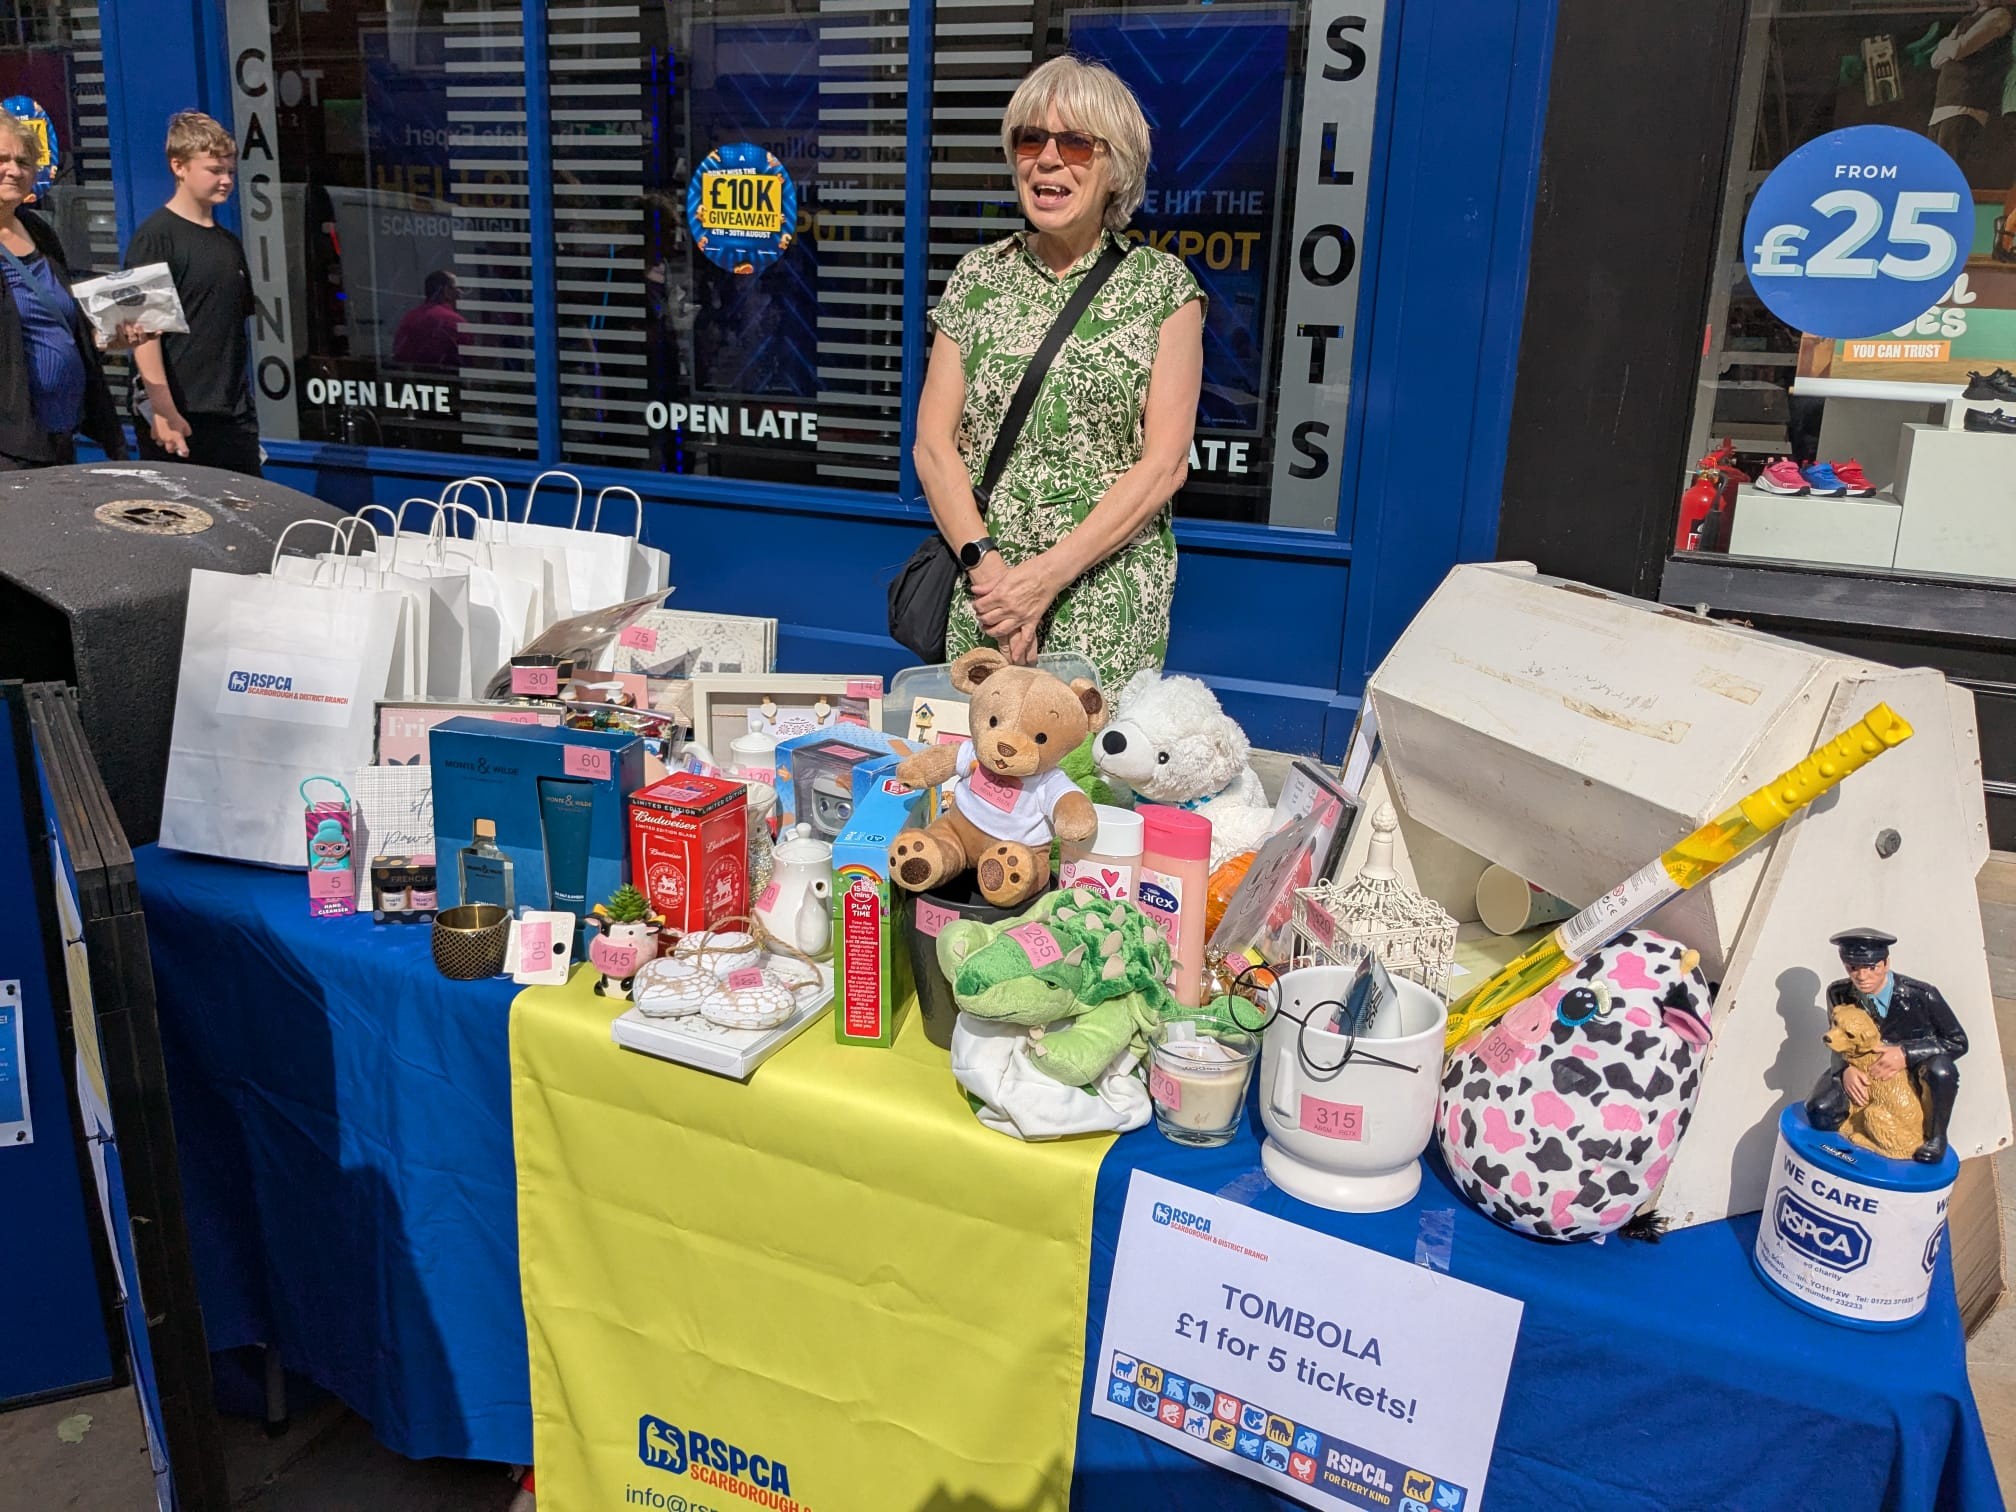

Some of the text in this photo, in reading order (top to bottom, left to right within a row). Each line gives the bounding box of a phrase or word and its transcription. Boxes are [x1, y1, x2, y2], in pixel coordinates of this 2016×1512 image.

[742, 167, 757, 175] THE
[1834, 164, 1898, 179] FROM
[709, 177, 775, 213] £10K
[1164, 190, 1206, 214] HIT
[1212, 190, 1264, 216] THE
[235, 48, 292, 400] CASINO
[709, 211, 777, 228] GIVEAWAY!
[744, 231, 771, 239] AUGUST
[1751, 189, 1961, 282] £25
[1122, 230, 1261, 270] KPOT
[1287, 15, 1368, 481] SLOTS
[1853, 343, 1941, 359] YOU CAN TRUST
[307, 377, 452, 415] OPEN LATE
[645, 400, 819, 443] OPEN LATE
[1187, 439, 1250, 473] ATE
[634, 630, 649, 643] 75
[249, 672, 293, 692] RSPCA
[529, 672, 548, 686] 30
[247, 687, 294, 700] SCARBOROUGH
[299, 693, 325, 703] DISTRICT
[324, 695, 349, 705] BRANCH
[387, 716, 427, 738] Fri
[477, 756, 491, 775] &
[492, 765, 519, 776] WILDE
[581, 753, 601, 768] 60
[565, 794, 575, 807] &
[632, 799, 696, 816] LIMITED EDITION
[702, 801, 725, 815] LIMITED
[632, 809, 697, 831] Budweiser
[635, 823, 697, 839] LIMITED EDITION GLASS
[331, 876, 341, 889] 5
[390, 875, 428, 883] FRENCH
[854, 891, 871, 899] mins
[1139, 888, 1174, 910] arex
[851, 903, 872, 911] PLAY
[852, 910, 871, 918] TIME
[532, 941, 545, 961] 50
[1025, 928, 1056, 958] 265
[602, 949, 630, 966] 145
[1488, 1035, 1514, 1065] 305
[1316, 1107, 1356, 1129] 315
[1783, 1154, 1879, 1215] WE CARE
[1172, 1207, 1211, 1234] RSPCA
[1781, 1203, 1853, 1258] RSPCA
[1170, 1221, 1213, 1244] SCARBOROUGH
[1218, 1237, 1244, 1253] DISTRICT
[1244, 1245, 1269, 1262] BRANCH
[1814, 1266, 1843, 1282] charity
[1805, 1286, 1834, 1302] number
[1856, 1295, 1870, 1303] Tel:
[1222, 1283, 1382, 1366] TOMBOLA
[1174, 1312, 1418, 1424] £1 for 5 tickets!
[688, 1430, 791, 1497] RSPCA
[1326, 1448, 1394, 1492] RSPCA.
[690, 1463, 800, 1512] SCARBOROUGH
[1323, 1471, 1391, 1505] FOR EVERY KIND
